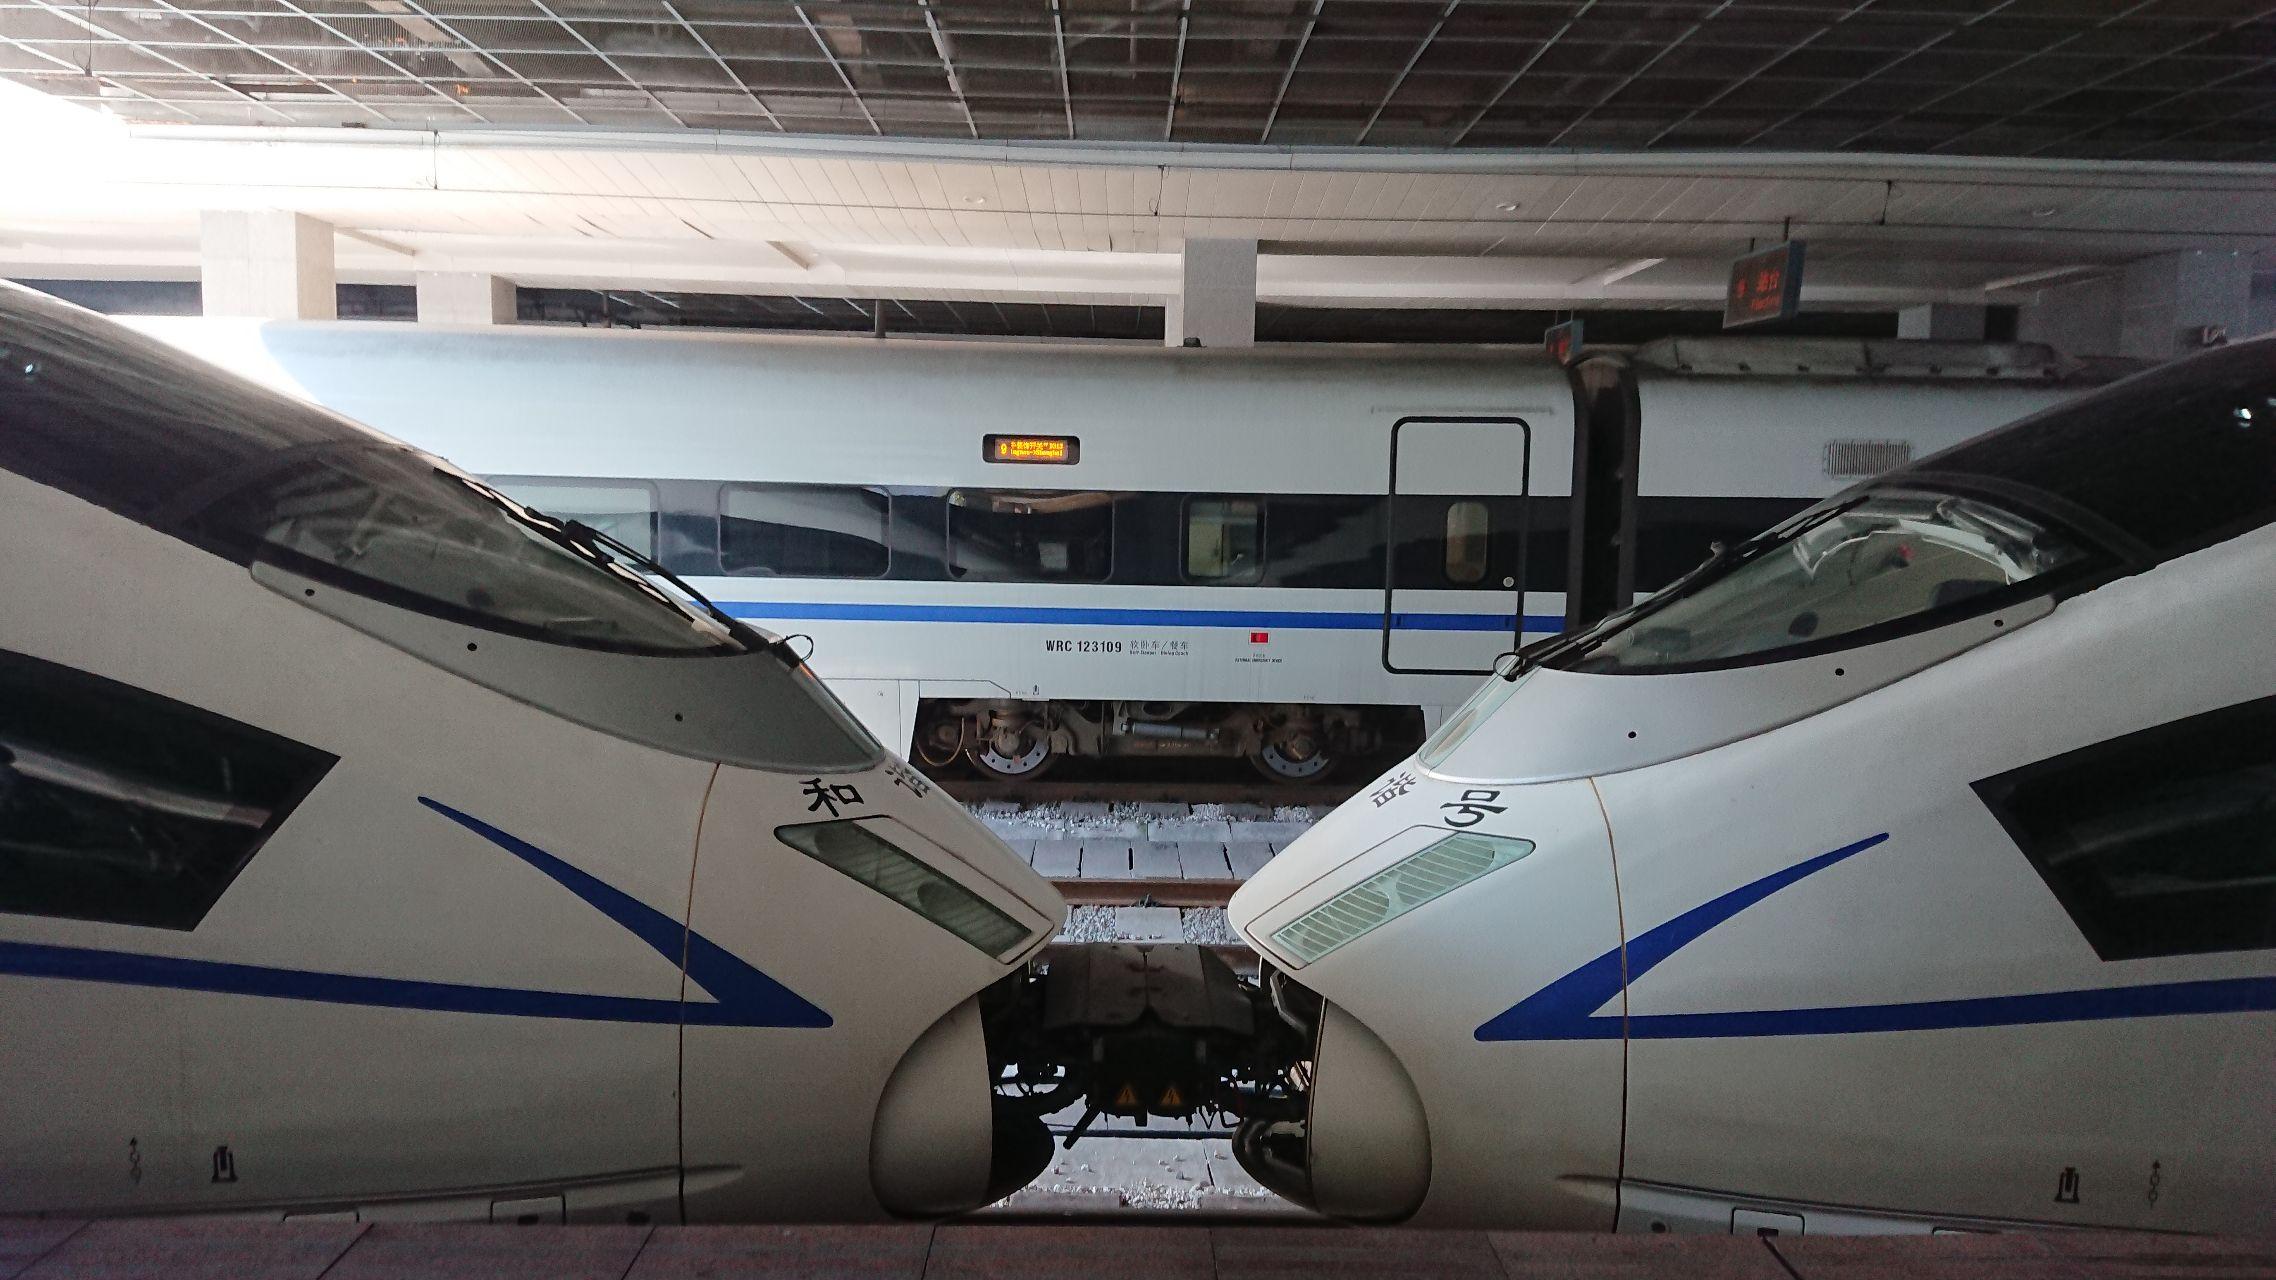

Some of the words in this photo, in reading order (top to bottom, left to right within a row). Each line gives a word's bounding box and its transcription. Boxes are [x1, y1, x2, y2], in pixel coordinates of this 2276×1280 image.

[1000, 443, 1008, 455] 9
[1046, 640, 1072, 652] WRC
[1077, 640, 1122, 653] 123109
